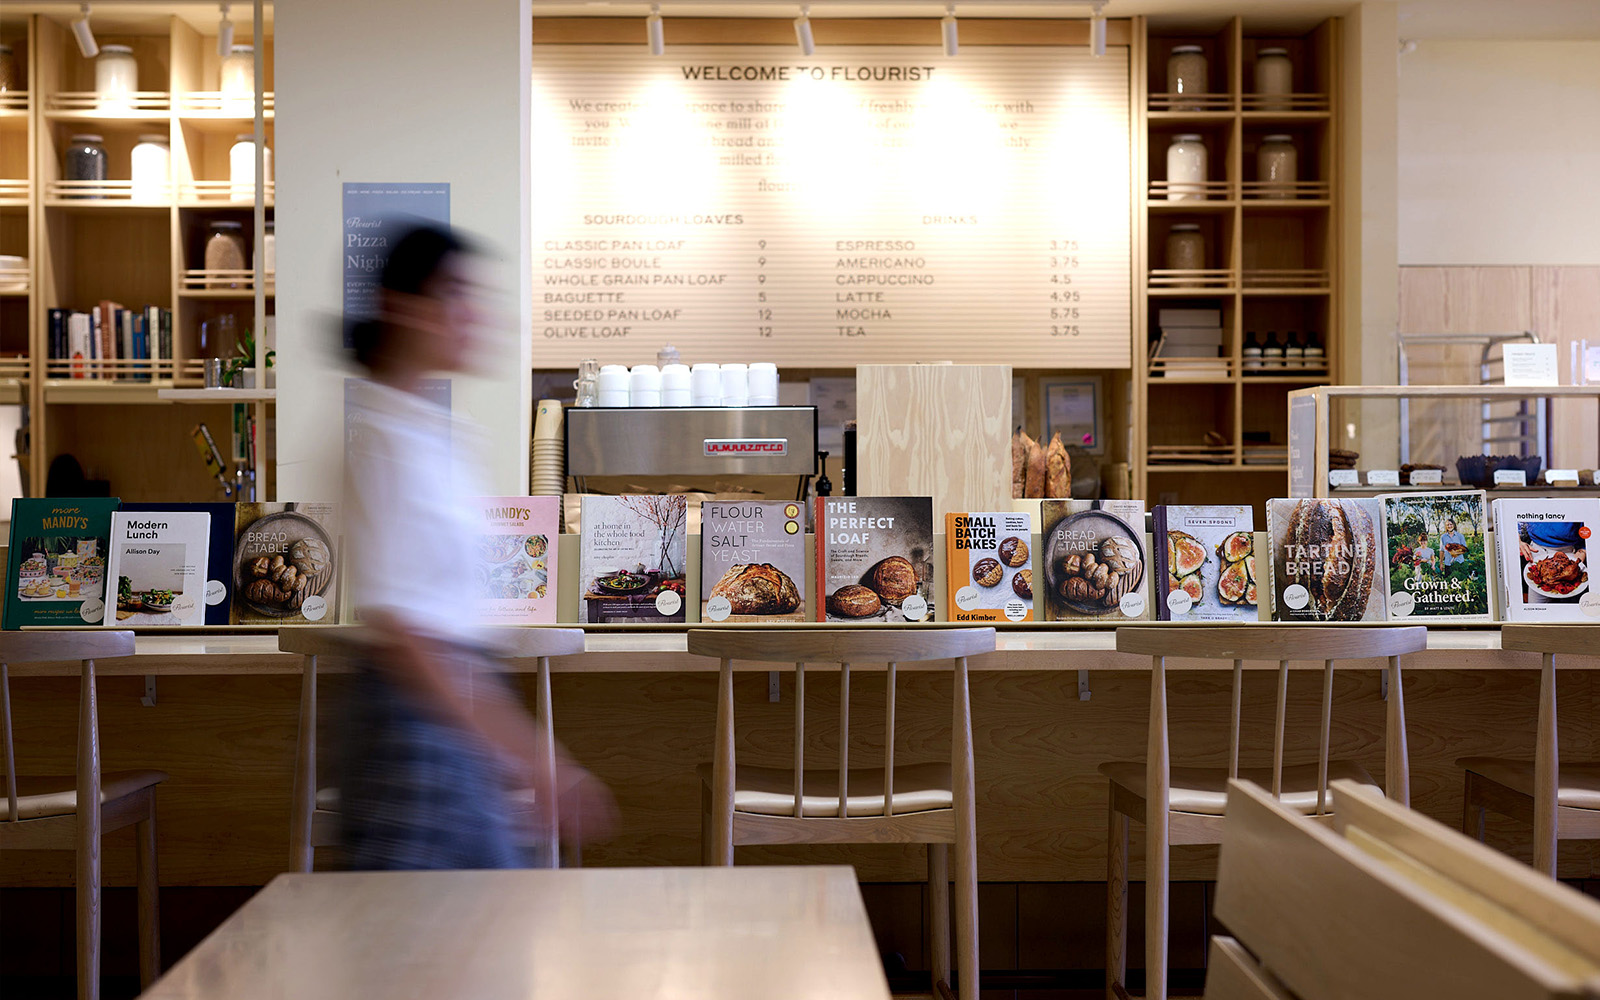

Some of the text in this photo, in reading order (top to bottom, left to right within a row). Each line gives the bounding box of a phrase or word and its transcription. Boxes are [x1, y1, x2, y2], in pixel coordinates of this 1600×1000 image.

[682, 66, 790, 80] WELCOME
[832, 66, 935, 81] FLOURIST
[569, 99, 592, 112] We
[730, 101, 744, 112] to
[1003, 100, 1034, 113] with
[727, 118, 751, 129] mill
[712, 136, 753, 147] bread
[684, 215, 744, 225] LOAVES
[923, 215, 978, 225] DRINKS
[347, 233, 388, 247] Pizza
[544, 240, 766, 251] CLASSIC PAN LOAF 9
[836, 240, 1079, 251] ESPRESSO 3.75
[544, 257, 766, 269] CLASSIC BOULE 9
[836, 257, 1079, 269] AMERICANO 3.75
[544, 274, 598, 285] WHOLE
[603, 274, 649, 285] GRAIN
[653, 274, 684, 285] PAN
[688, 274, 727, 285] LOAF
[836, 274, 1072, 285] CAPPUCCINO 4.5
[544, 292, 766, 303] BAGUETTE 5
[836, 292, 1080, 303] LATTE 4.95
[544, 309, 772, 321] SEEDED PAN LOAF 12
[836, 309, 1080, 321] MOCHA 5.75
[544, 327, 772, 338] OLIVE LOAF 12
[836, 327, 1080, 338] TEA 3.75
[484, 507, 531, 520] MANDY'S
[711, 507, 763, 518] FLOUR
[828, 502, 857, 514] THE
[42, 516, 89, 530] MANDY'S
[127, 521, 168, 530] Modern
[711, 521, 765, 533] WATER
[830, 518, 895, 529] PERFECT
[955, 517, 996, 527] SMALL
[127, 530, 158, 539] Lunch
[248, 532, 287, 542] BREAD
[607, 530, 628, 538] whole
[630, 530, 645, 538] food
[830, 533, 870, 544] LOAF
[956, 528, 996, 538] BATCH
[1057, 530, 1096, 540] BREAD
[711, 535, 748, 547] SALT
[956, 539, 996, 549] BAKES
[1064, 541, 1099, 551] TABLE
[254, 543, 289, 553] TABLE
[1284, 544, 1366, 557] TARTINE
[711, 550, 760, 561] YEAST
[1285, 562, 1351, 576] BREAD
[1404, 577, 1462, 590] Grown &
[1412, 590, 1475, 603] Gathered.
